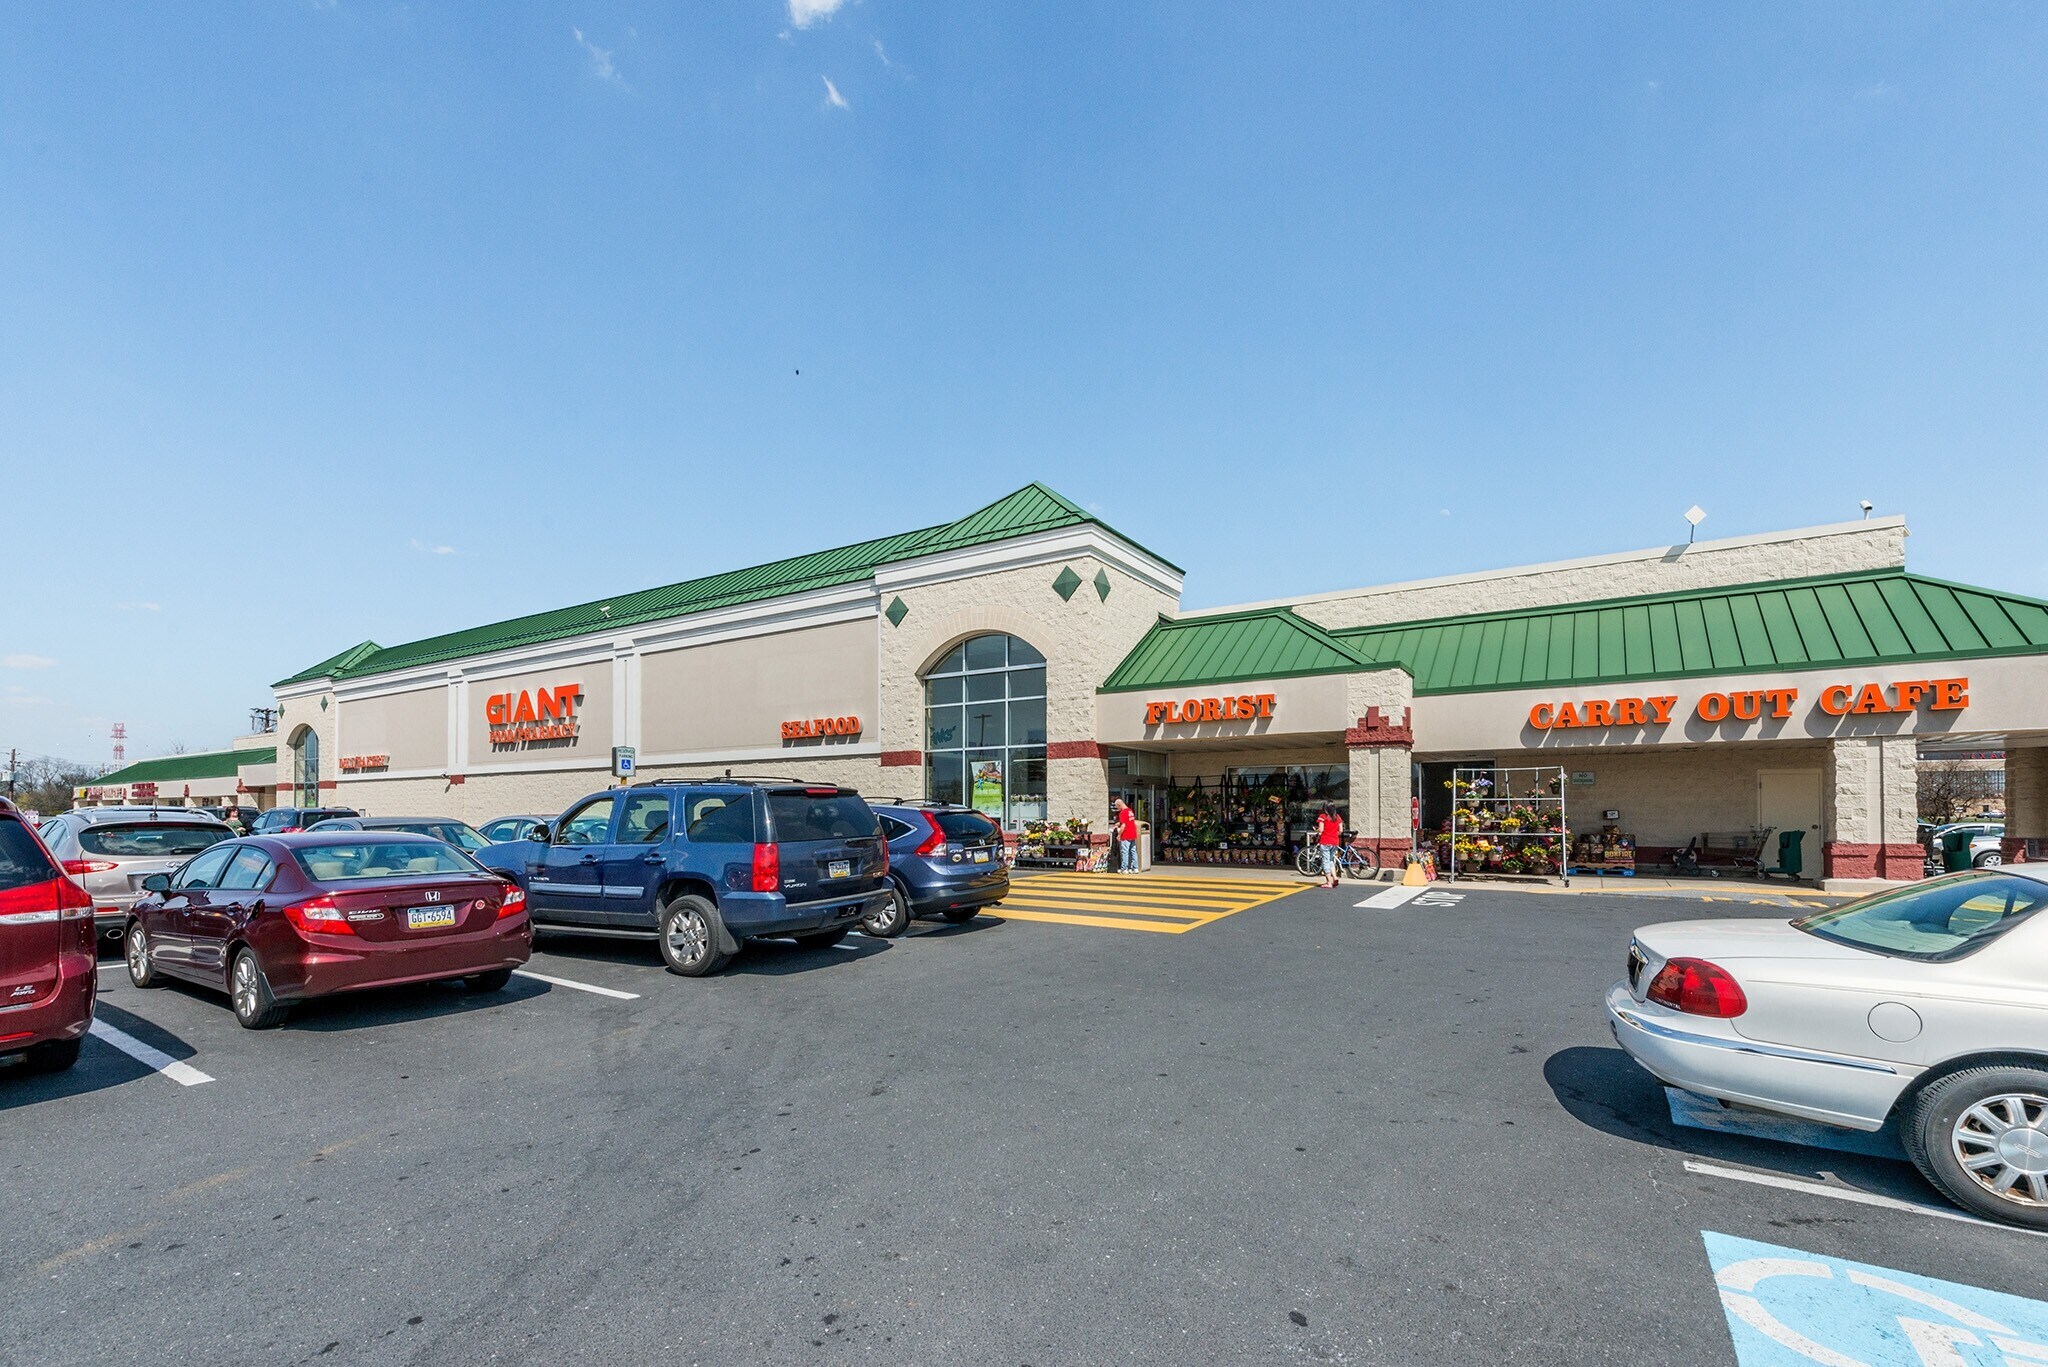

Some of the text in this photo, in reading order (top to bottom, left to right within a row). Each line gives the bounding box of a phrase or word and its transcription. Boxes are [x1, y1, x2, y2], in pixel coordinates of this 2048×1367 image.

[486, 683, 579, 725] GIANT
[1146, 693, 1275, 725] FLORIST
[1529, 677, 1970, 730] CARRY OUT CAFE
[489, 723, 575, 743] FOOD/PHARMACY
[781, 716, 859, 738] SEAFOOD
[1604, 850, 1632, 858] BONFIRE
[1411, 891, 1466, 907] STOP
